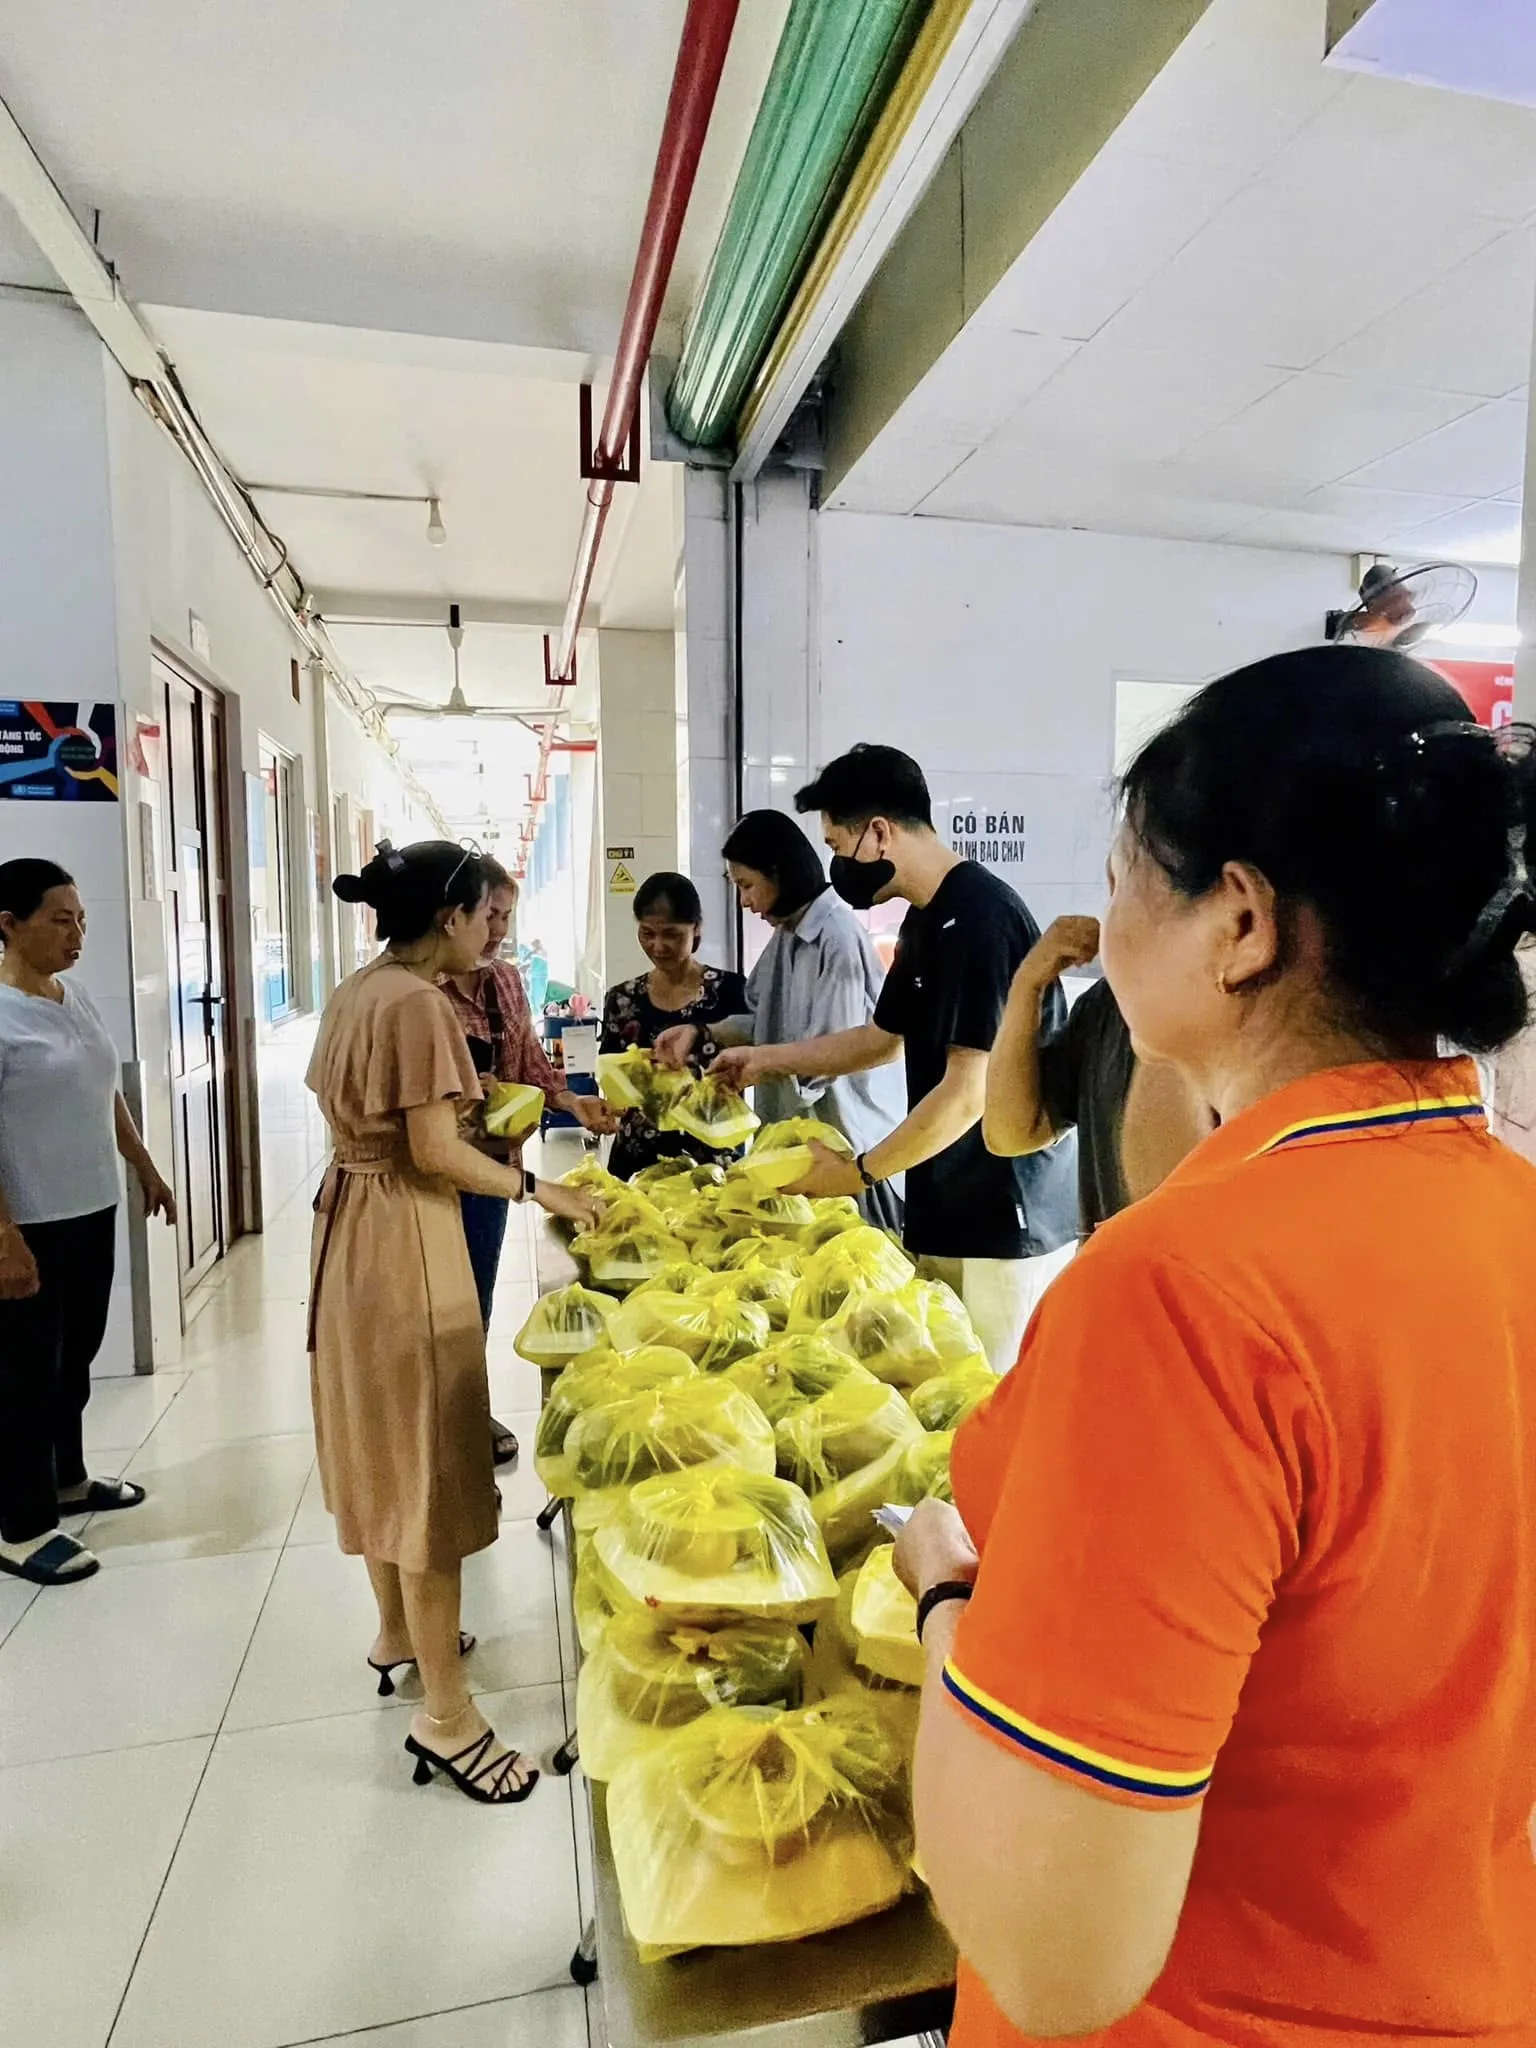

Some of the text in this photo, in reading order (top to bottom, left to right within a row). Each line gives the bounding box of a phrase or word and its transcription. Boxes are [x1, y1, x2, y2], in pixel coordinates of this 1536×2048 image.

[953, 811, 1025, 834] CÓ BÁN
[980, 840, 999, 863] BAO
[1001, 840, 1025, 863] CHAY
